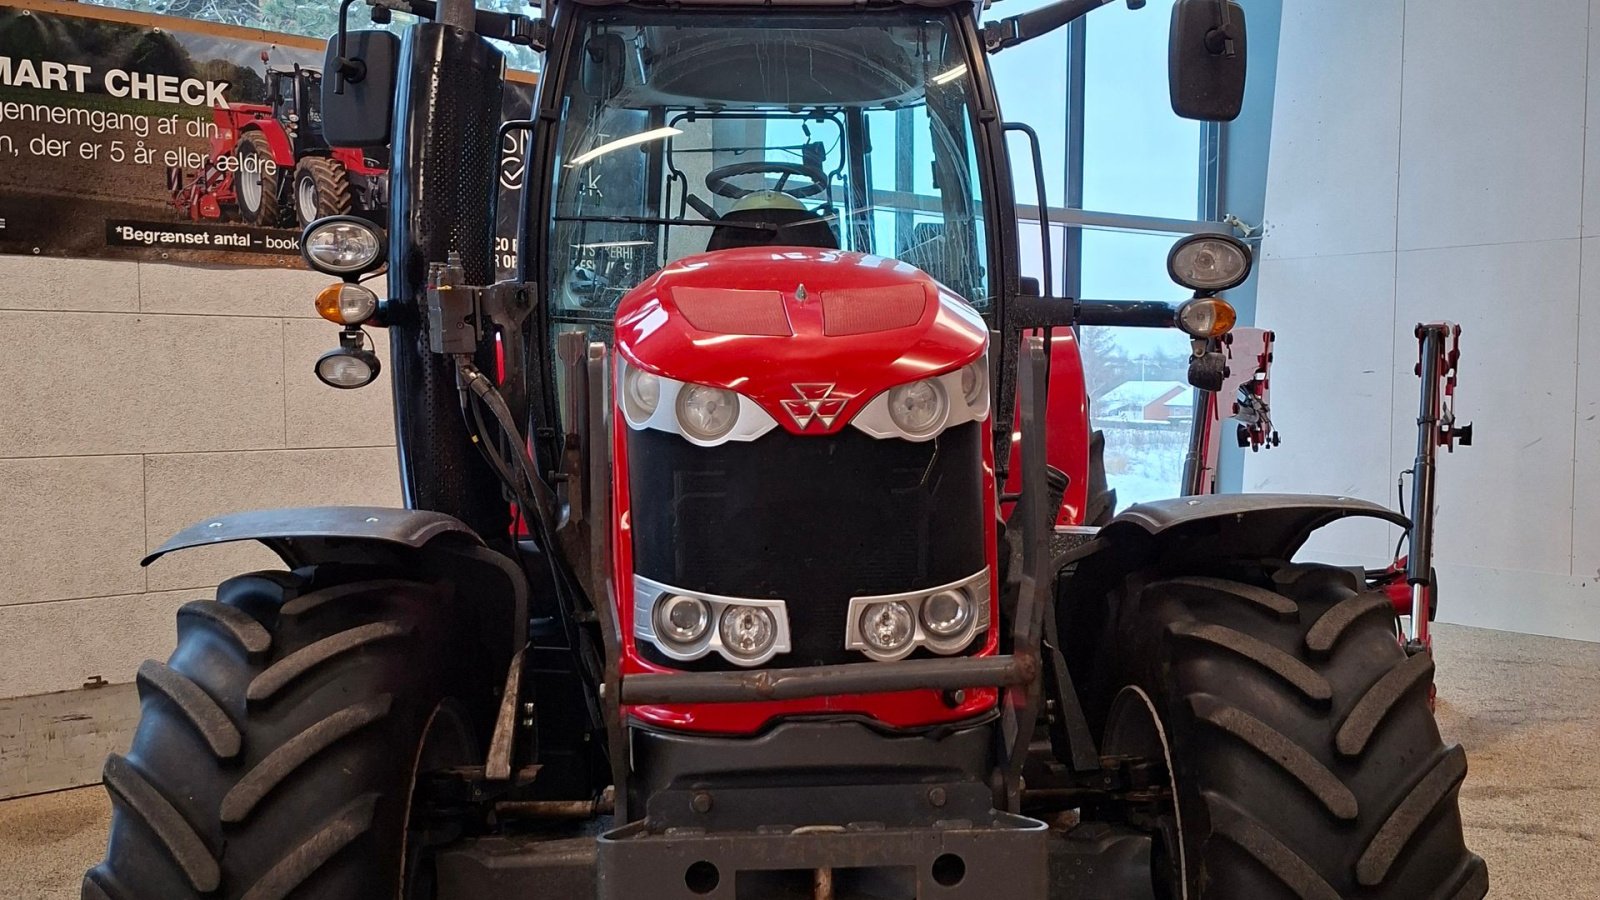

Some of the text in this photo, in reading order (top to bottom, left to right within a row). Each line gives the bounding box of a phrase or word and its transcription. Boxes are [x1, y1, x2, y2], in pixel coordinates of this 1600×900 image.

[104, 68, 230, 109] CHECK
[0, 101, 218, 138] ennemgang af din
[29, 133, 71, 157] der
[79, 142, 102, 160] er
[110, 141, 125, 162] 5
[134, 140, 157, 164] år
[164, 146, 209, 169] eller
[216, 152, 277, 175] ældre
[214, 232, 250, 247] antal
[265, 235, 300, 250] book
